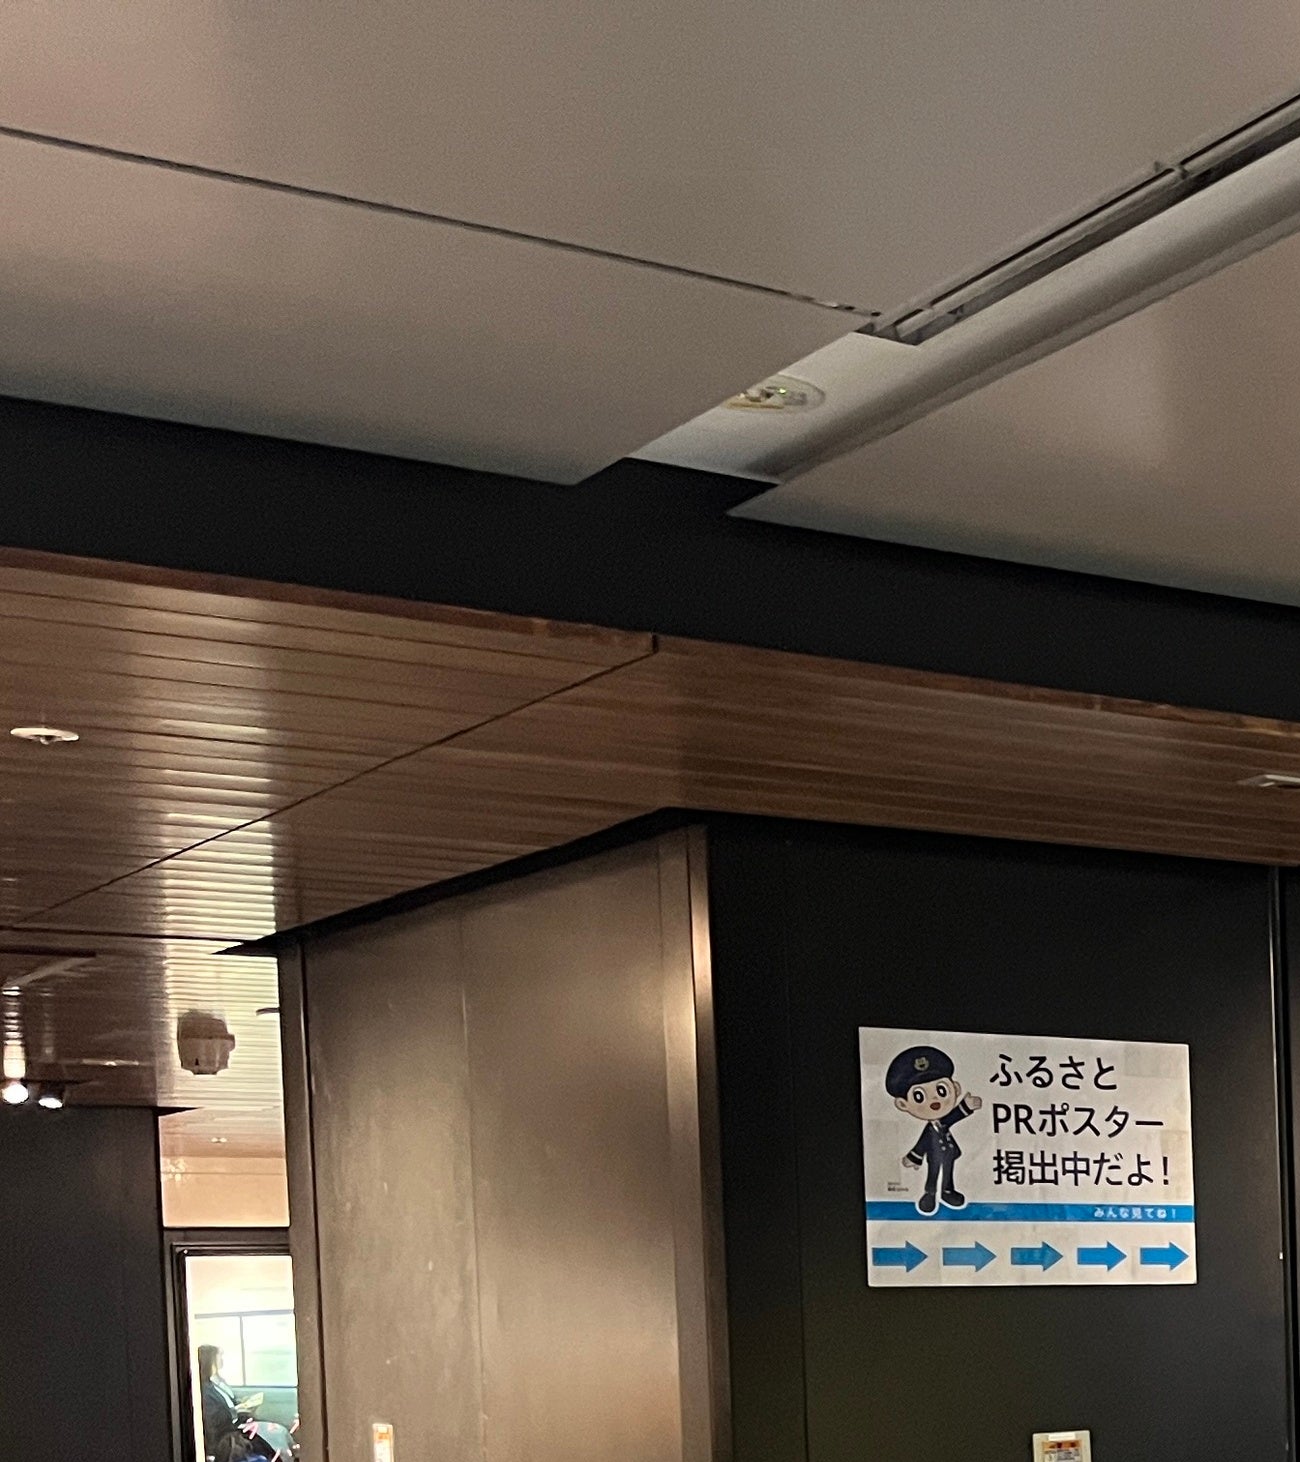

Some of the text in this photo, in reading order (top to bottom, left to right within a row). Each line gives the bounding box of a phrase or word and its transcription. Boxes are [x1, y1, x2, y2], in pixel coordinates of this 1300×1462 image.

[989, 1053, 1119, 1091] ふるさと
[992, 1101, 1164, 1138] PRポスター
